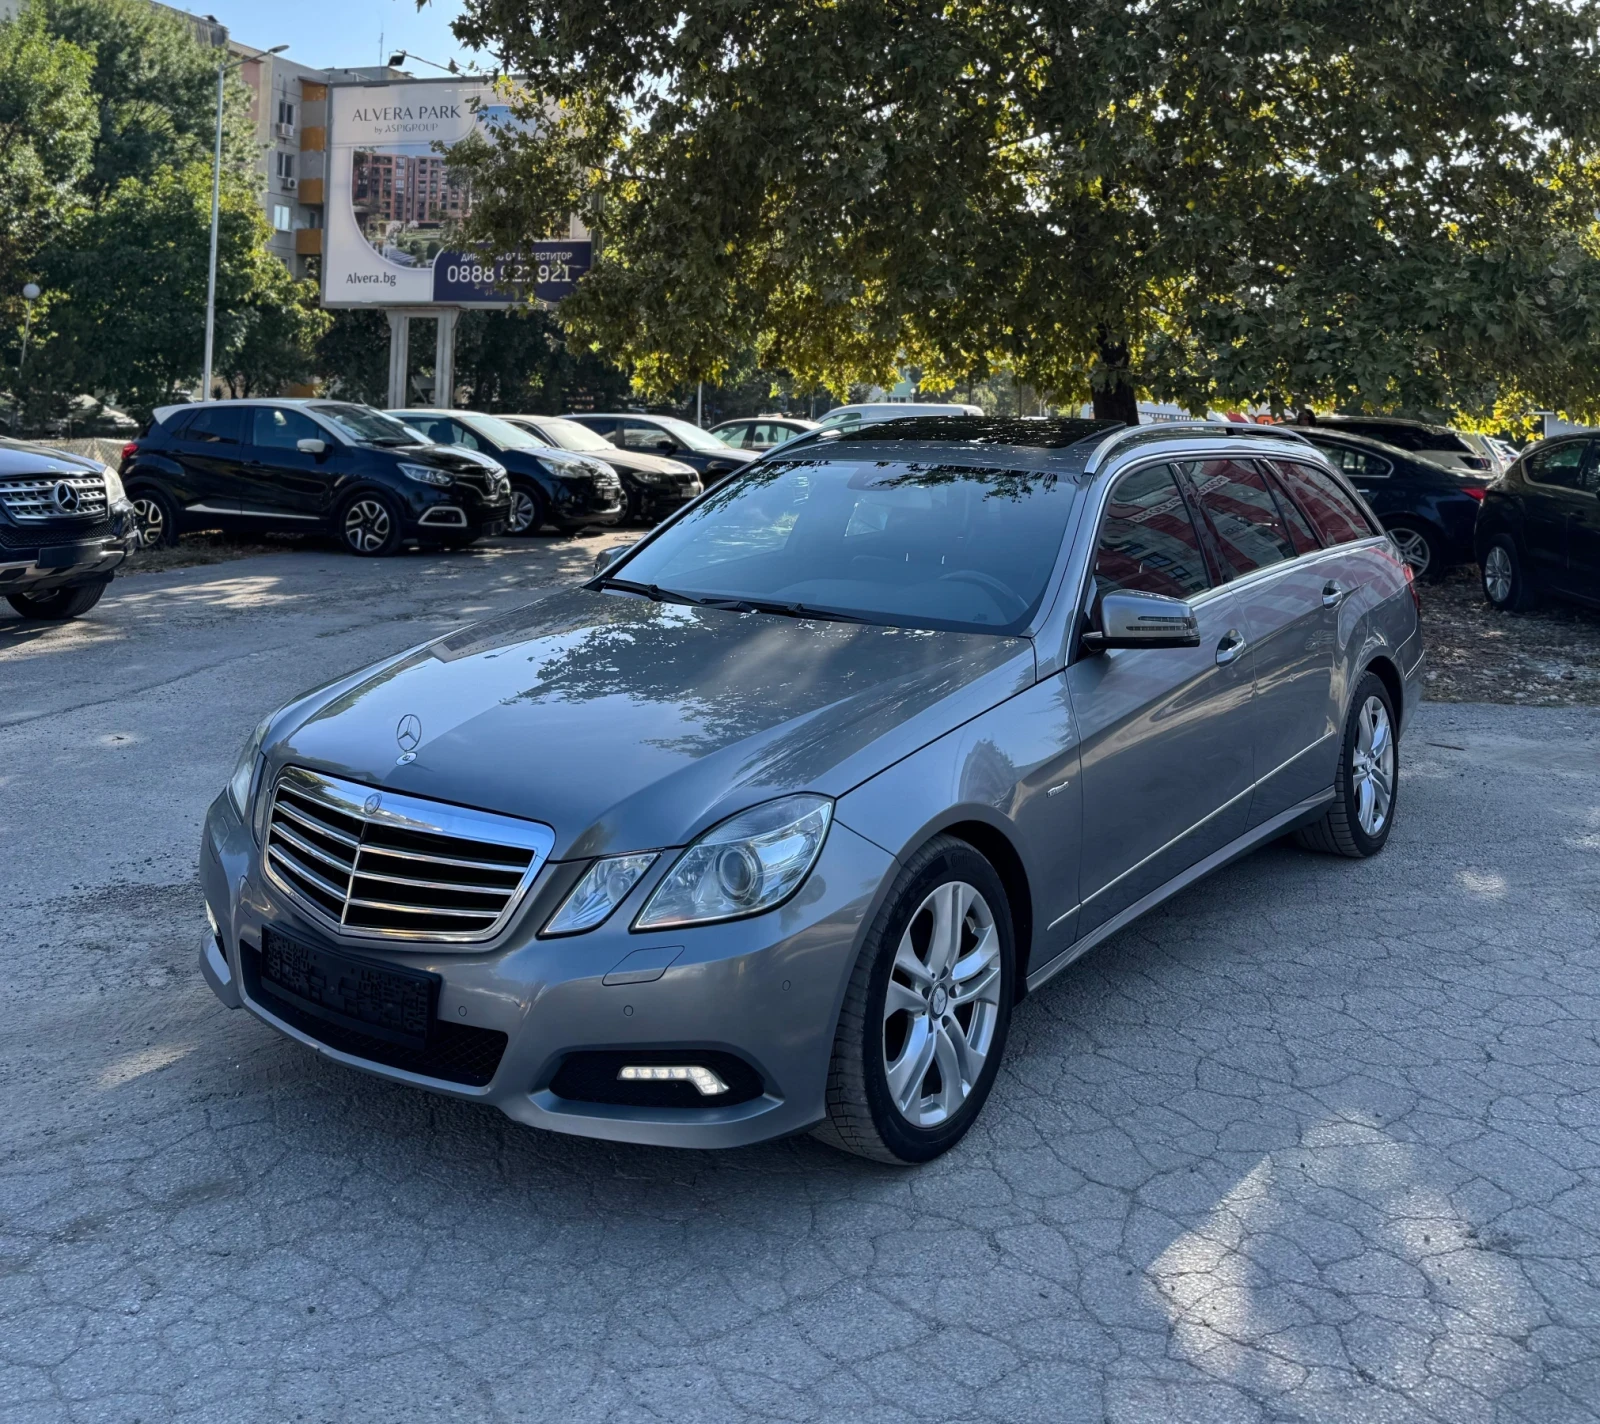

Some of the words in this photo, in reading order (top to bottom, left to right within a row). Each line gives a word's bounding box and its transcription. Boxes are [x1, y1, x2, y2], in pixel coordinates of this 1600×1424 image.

[352, 106, 413, 122] ALVERA
[419, 104, 461, 119] PARK
[374, 126, 383, 135] by
[385, 122, 438, 133] ASPIGROUP
[346, 271, 397, 287] Alvera.bg
[447, 265, 495, 283] 0888
[538, 265, 572, 282] 921
